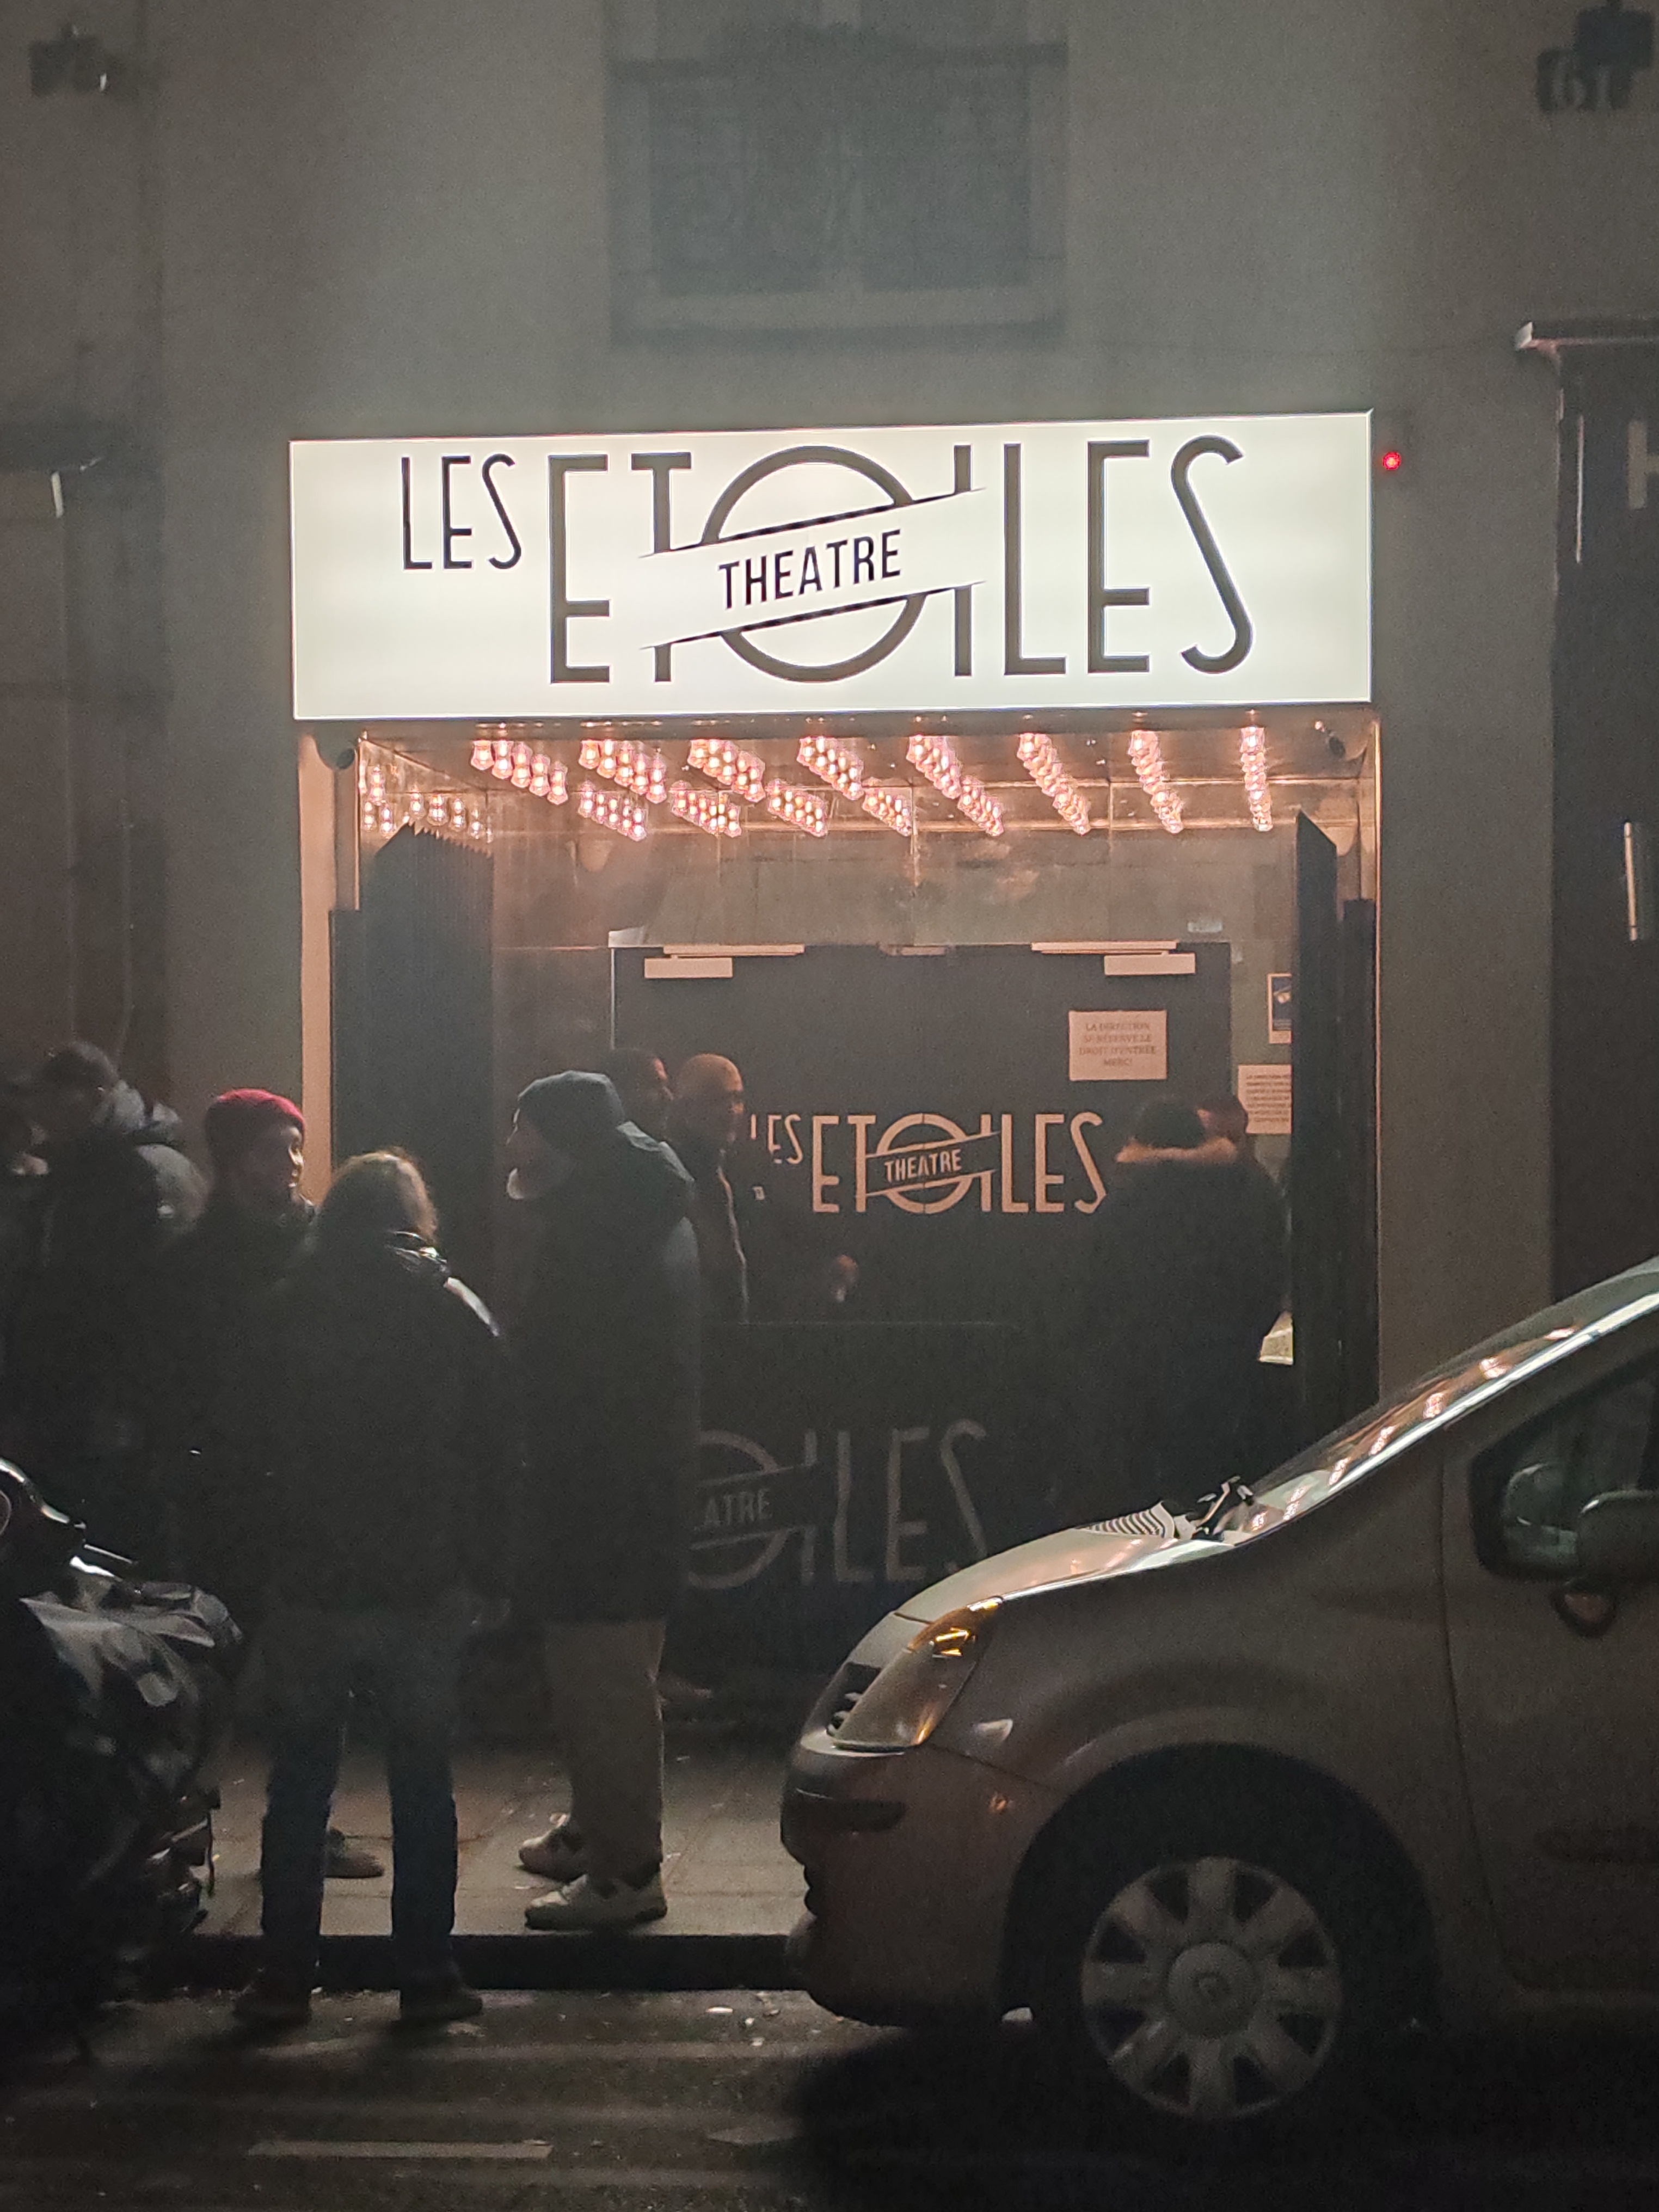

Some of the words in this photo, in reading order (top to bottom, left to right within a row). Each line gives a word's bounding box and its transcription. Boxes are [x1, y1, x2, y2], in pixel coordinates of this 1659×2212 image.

[402, 454, 521, 569] LES
[548, 435, 1252, 684] ETOILES
[718, 529, 901, 610] THEATRE
[812, 1111, 1107, 1214] ETOILES
[884, 1148, 962, 1183] THEATRE
